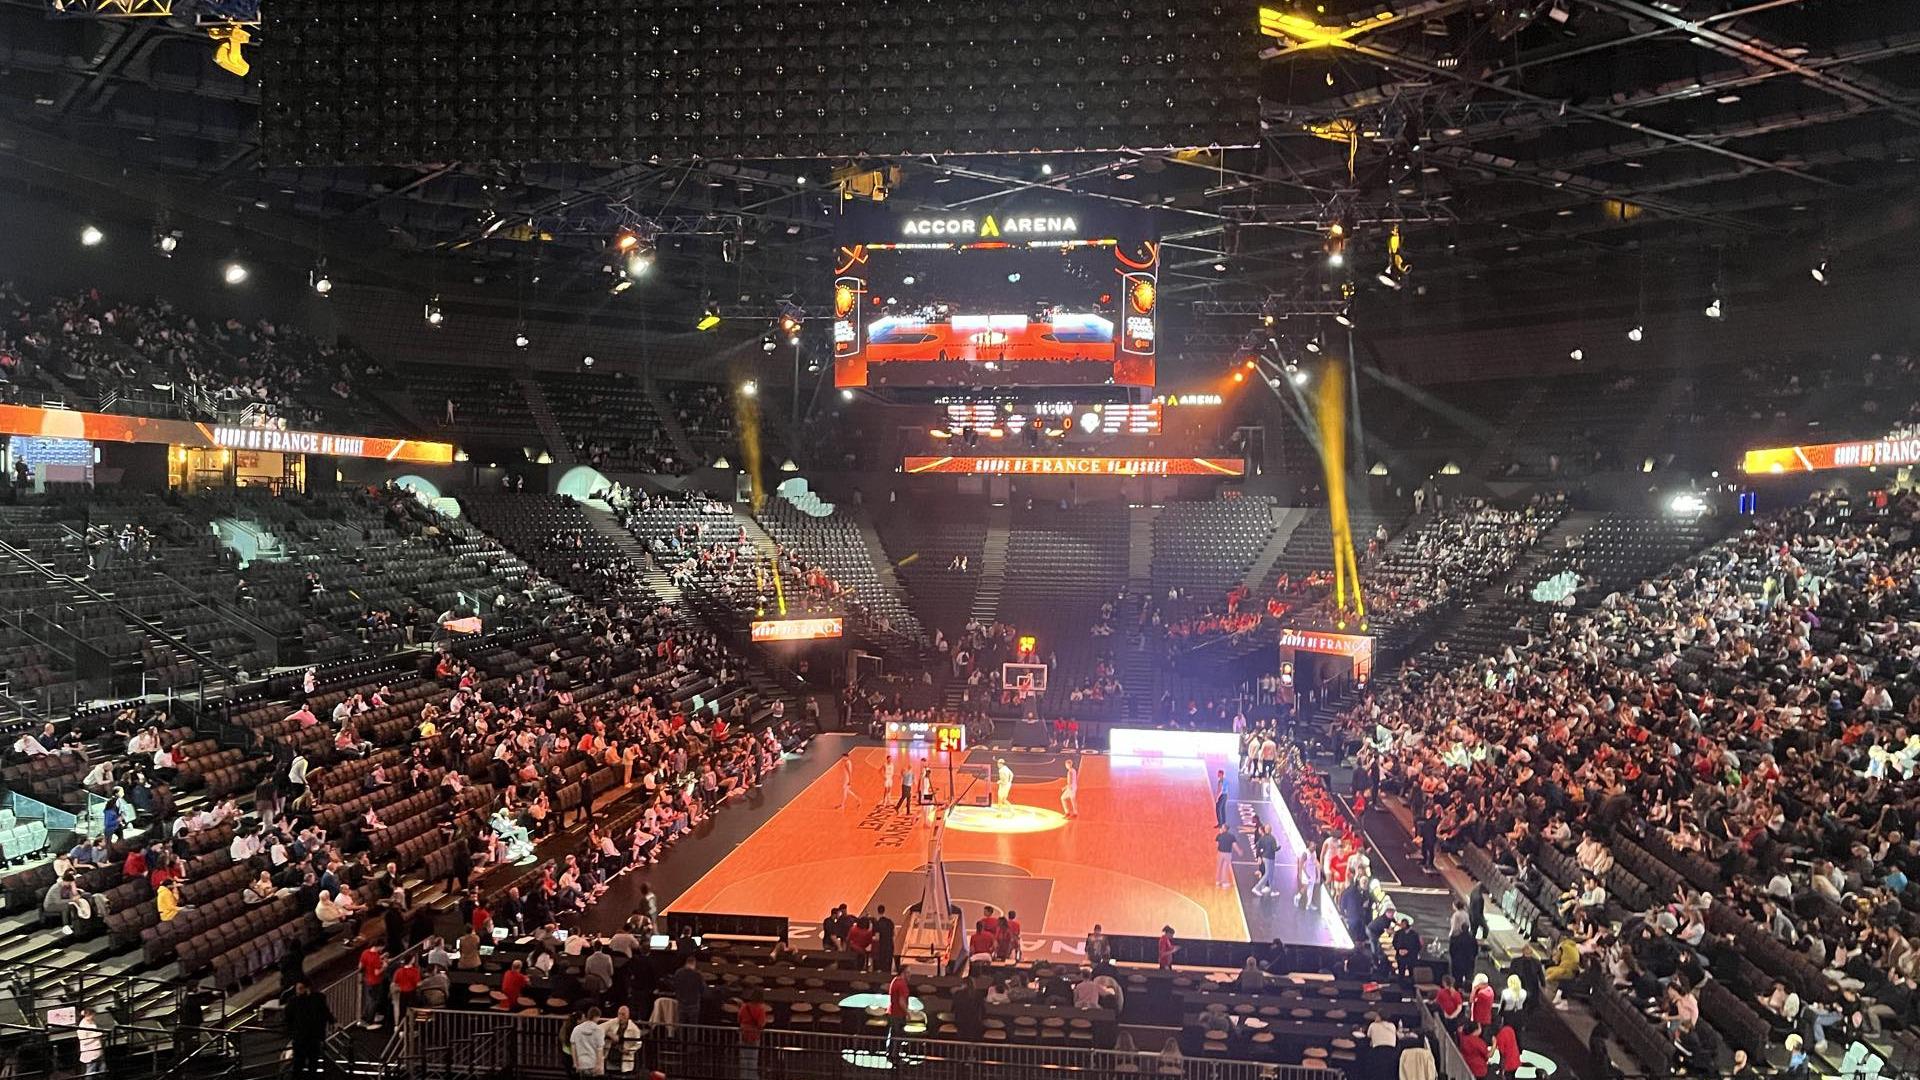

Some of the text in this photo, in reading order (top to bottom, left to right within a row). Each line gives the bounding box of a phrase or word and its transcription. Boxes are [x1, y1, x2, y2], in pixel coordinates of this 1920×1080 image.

[904, 219, 976, 235] ACCOR
[1003, 217, 1077, 232] ARENA
[1180, 394, 1222, 405] ARENA
[263, 431, 319, 451] FRANCE
[1032, 459, 1100, 471] FRANCE
[940, 737, 958, 751] 24
